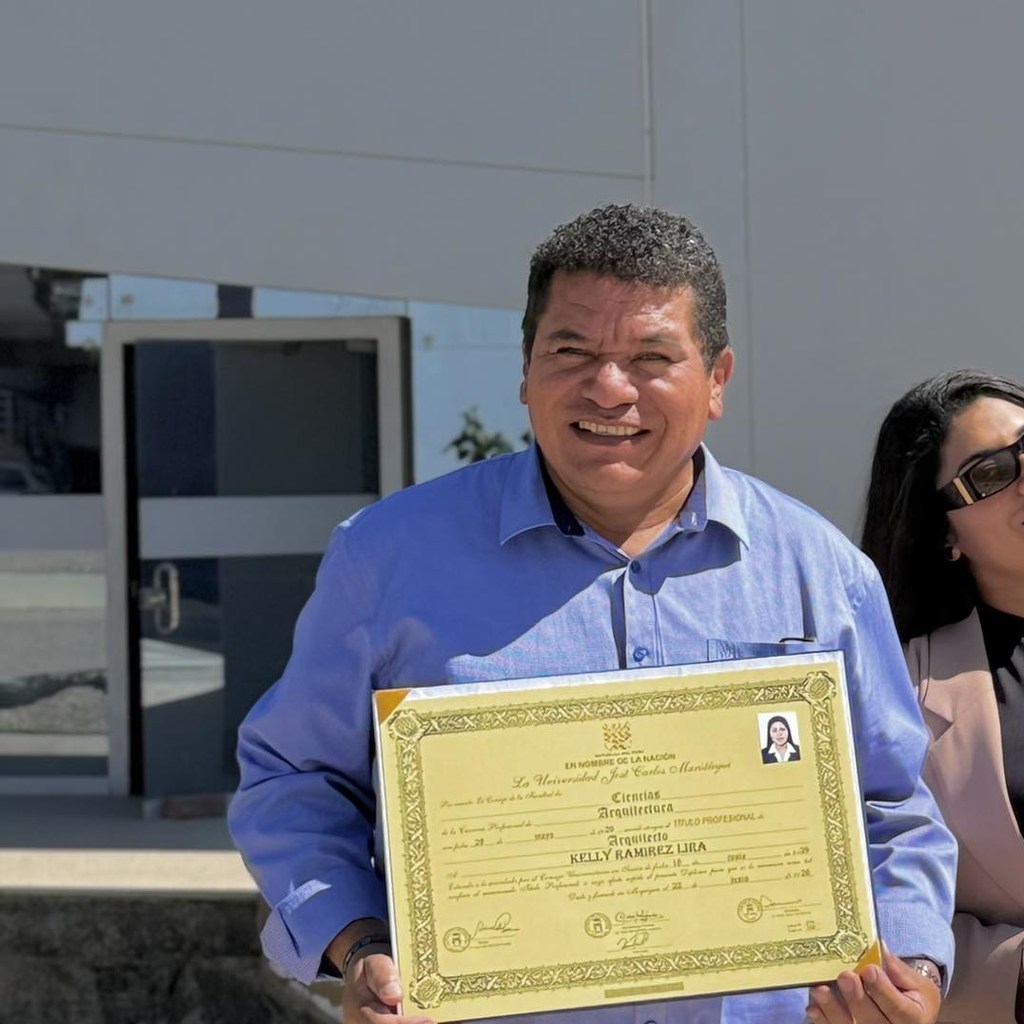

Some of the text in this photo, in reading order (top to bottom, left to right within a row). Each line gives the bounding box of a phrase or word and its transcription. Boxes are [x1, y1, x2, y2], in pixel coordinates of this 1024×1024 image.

[631, 755, 642, 764] LA
[611, 790, 661, 804] Ciencias
[597, 803, 674, 820] Arquitectura
[607, 832, 669, 847] Arquitecto
[570, 841, 707, 865] KELLY RAMIREZ LIRA
